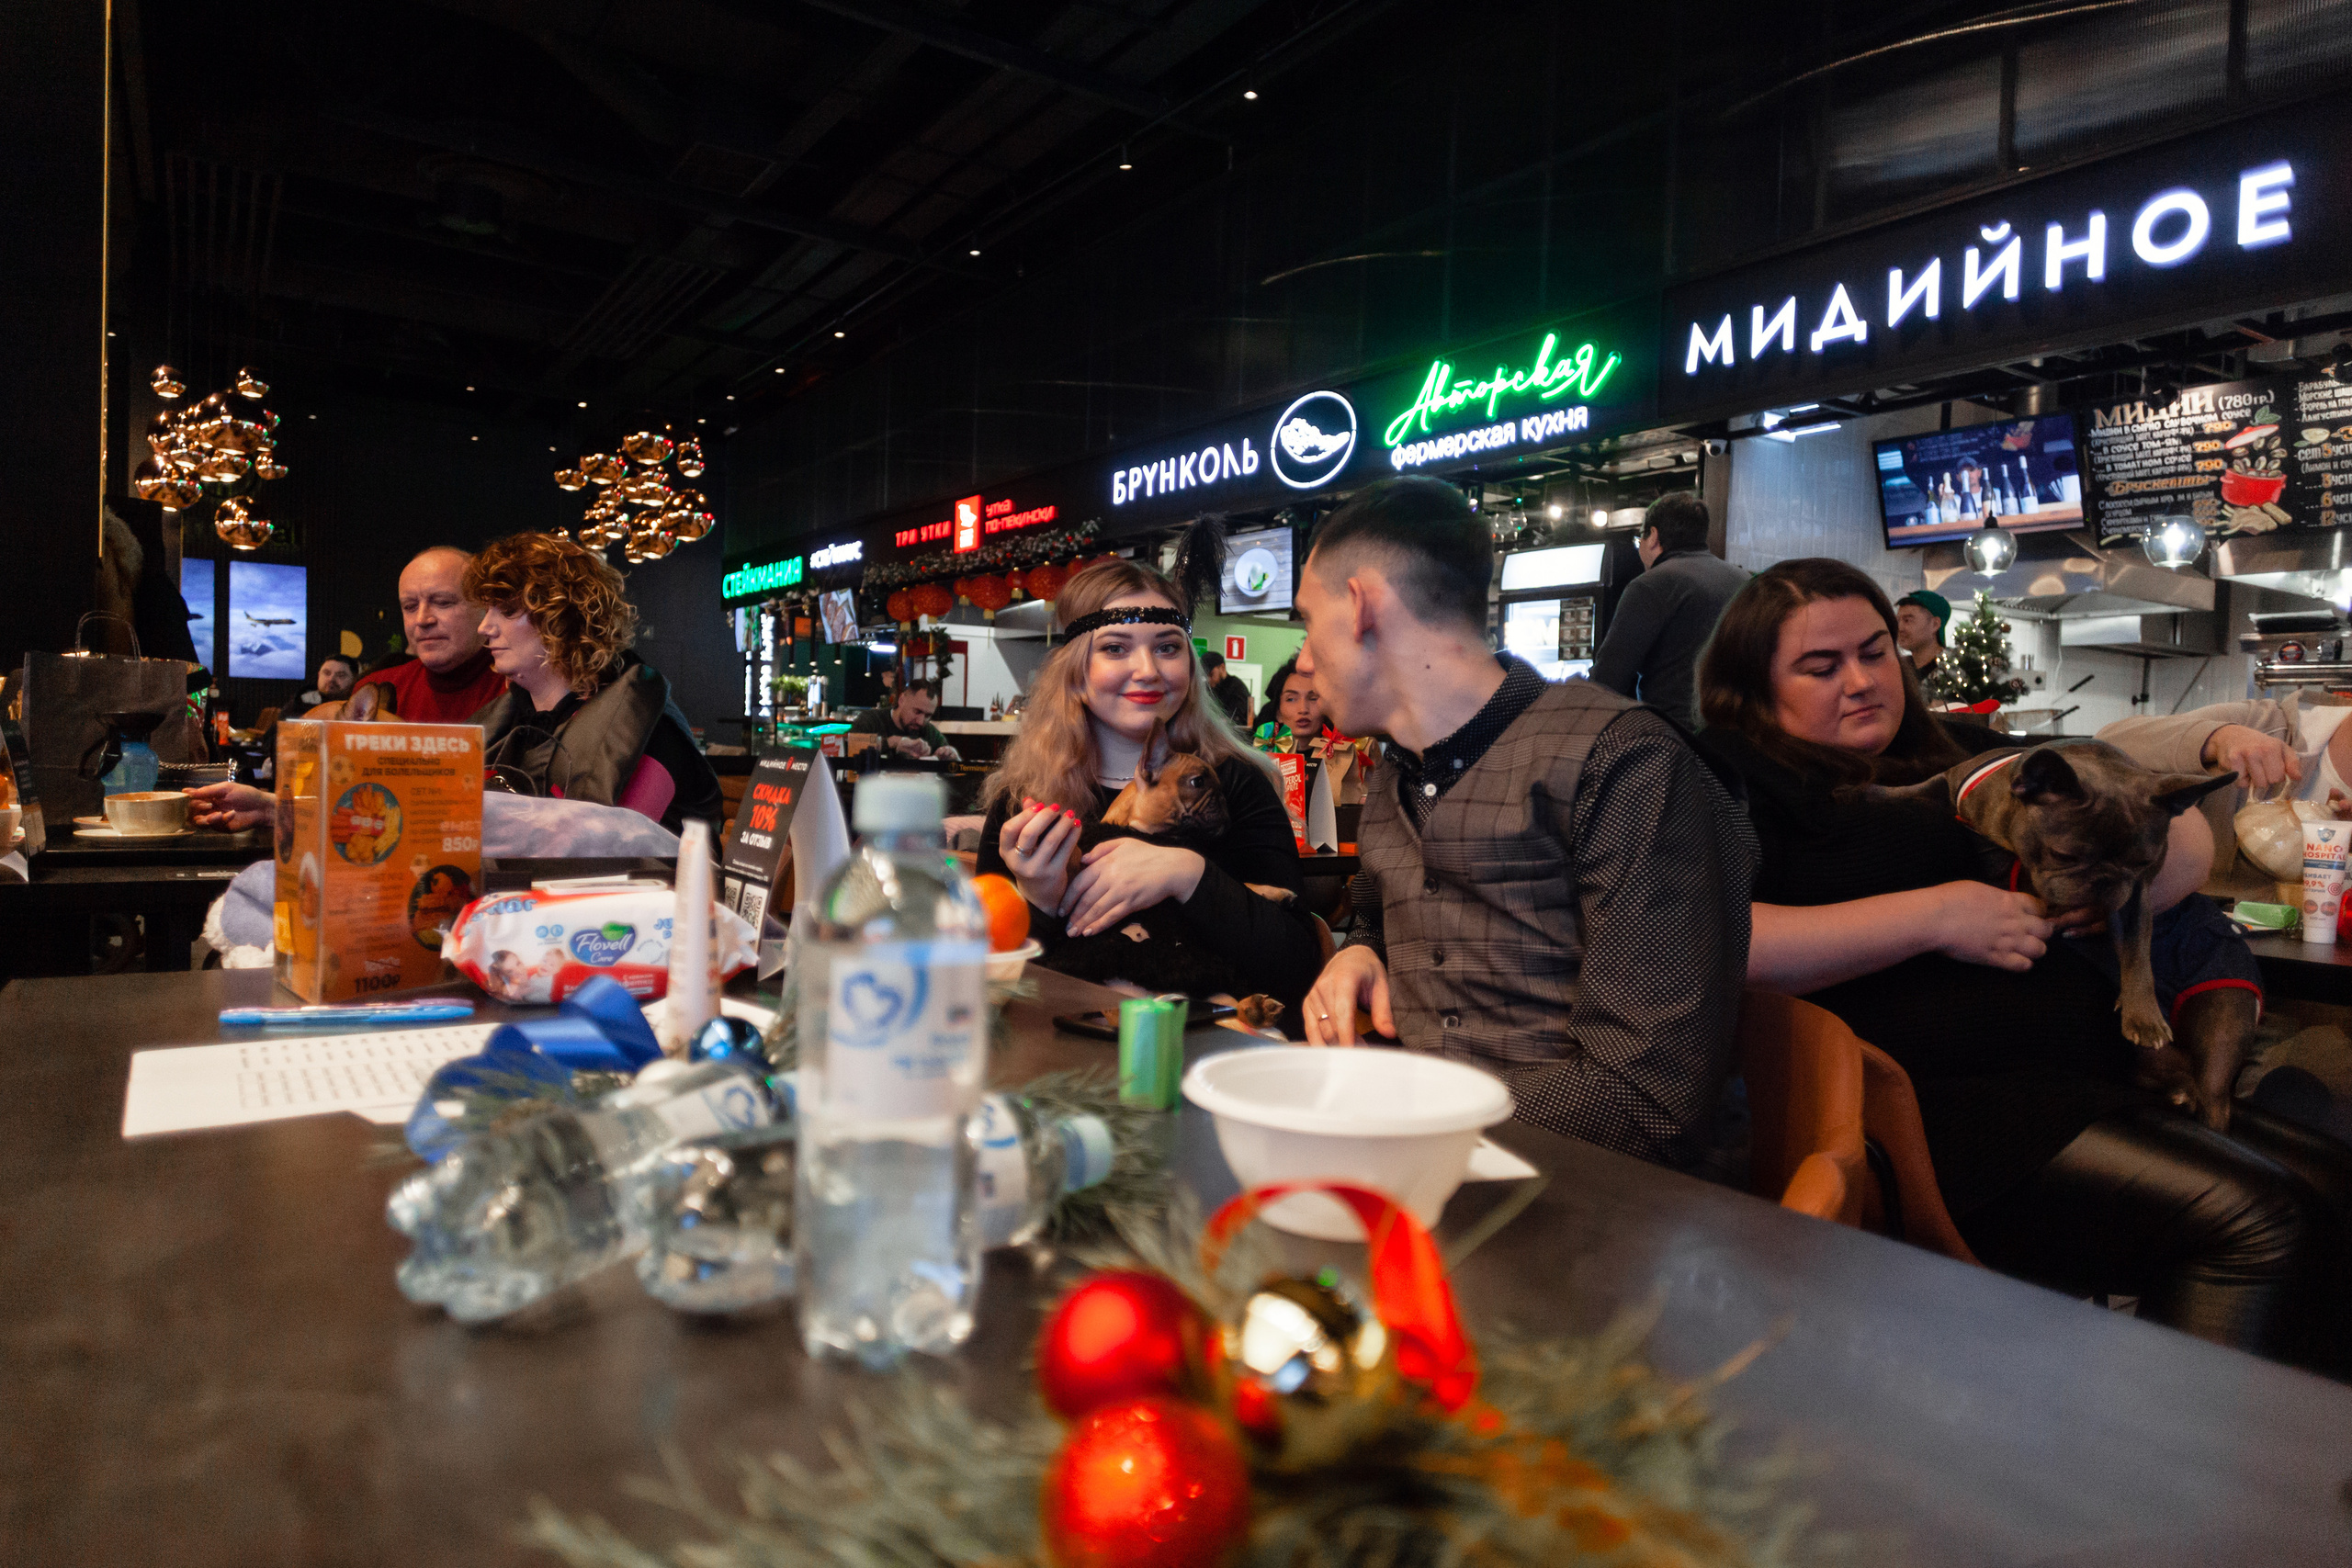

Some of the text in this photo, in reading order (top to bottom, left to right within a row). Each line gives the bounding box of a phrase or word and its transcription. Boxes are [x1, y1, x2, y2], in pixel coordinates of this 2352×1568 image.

[1684, 160, 2295, 375] МИДИЙНОЕ
[1385, 333, 1619, 446] Авторская
[1391, 422, 1516, 470] фермерская
[2193, 440, 2222, 454] 790
[1112, 437, 1260, 505] БРУНКОЛЬ
[2194, 458, 2223, 473] 790
[895, 528, 917, 547] ТРИ
[921, 520, 952, 542] УТКИ
[722, 556, 803, 600] СТЕЙКМАНИЯ
[345, 734, 470, 754] ГРЕКИ ЗДЕСЬ
[377, 757, 440, 766] СПЕЦИАЛЬНО
[361, 768, 456, 777] ДЛЯ БОЛЕЛЬЩИКОВ
[752, 783, 792, 805] СКИДКА
[749, 805, 779, 832] 10%
[741, 831, 773, 850] ЗА ОТЗЫВ
[2307, 843, 2343, 852] NANO
[576, 933, 632, 953] Flovell
[591, 953, 613, 963] Care
